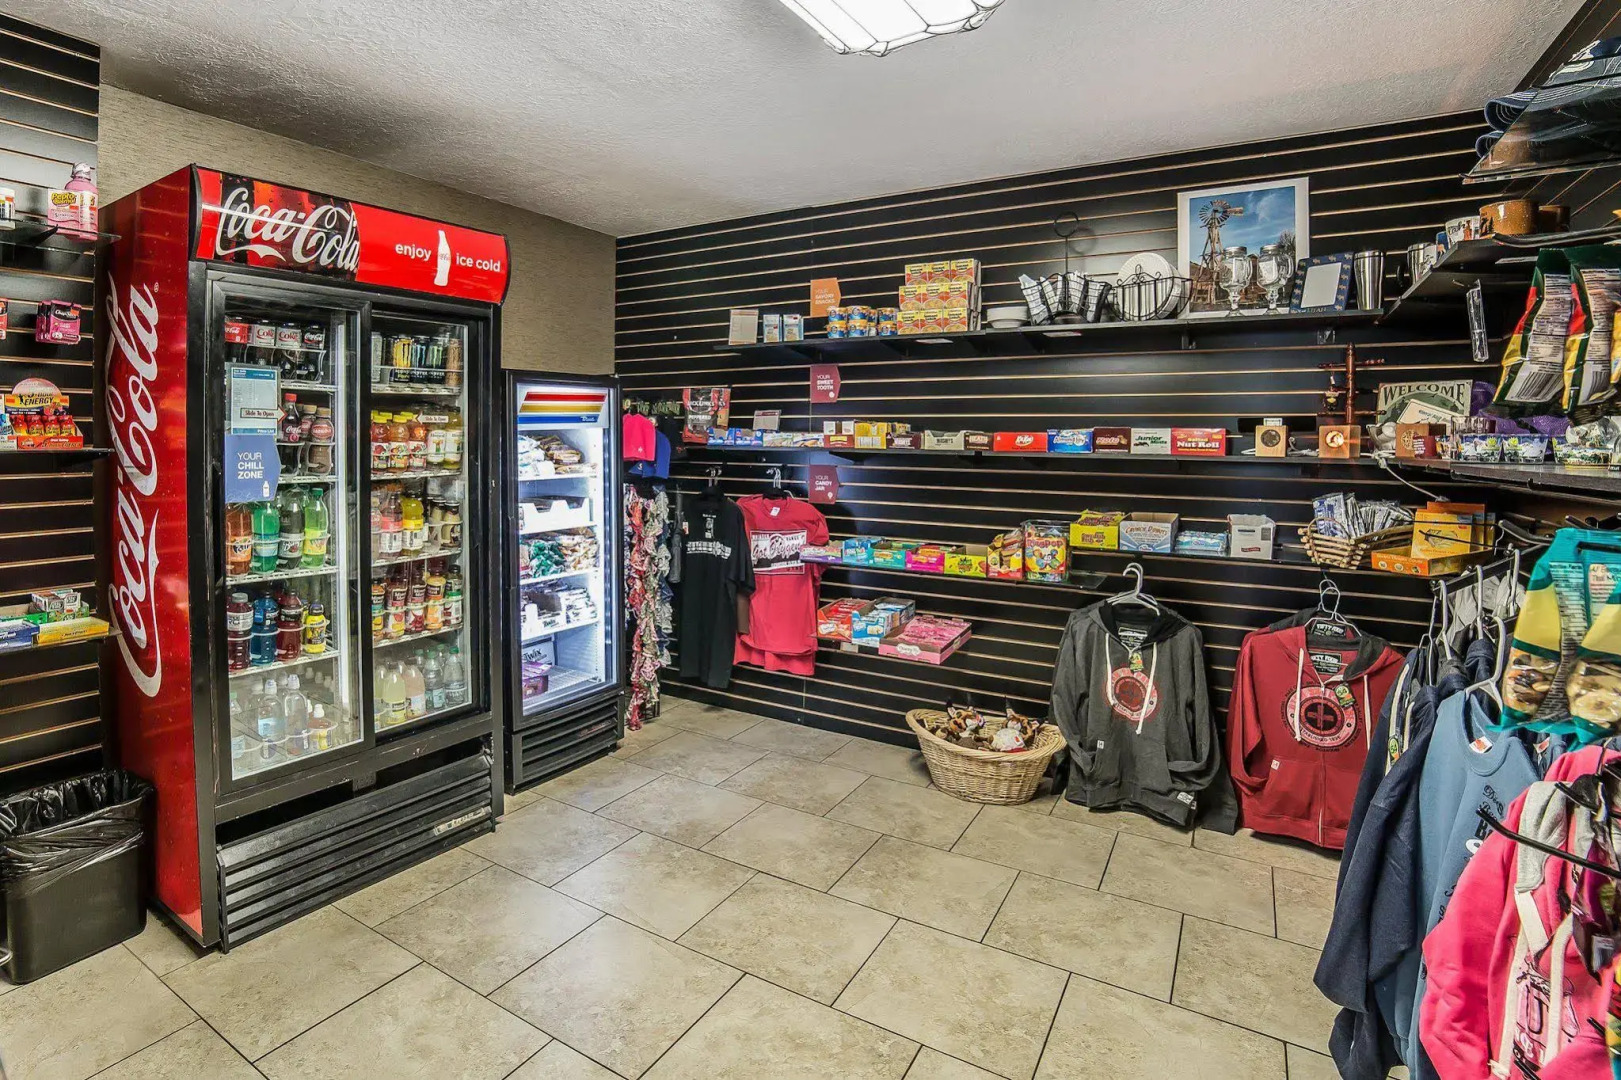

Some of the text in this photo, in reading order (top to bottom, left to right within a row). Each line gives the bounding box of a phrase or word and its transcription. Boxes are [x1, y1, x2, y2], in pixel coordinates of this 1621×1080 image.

[215, 187, 361, 272] Coca-Cola
[394, 242, 501, 273] enjoy ice cold
[1383, 383, 1465, 407] WELCOME
[24, 397, 54, 405] ENERGY
[1176, 441, 1220, 449] Nut Roll
[238, 452, 262, 461] YOUR
[237, 462, 265, 470] CHILL
[237, 470, 264, 479] ZONE
[106, 271, 163, 696] Coca-Cola
[522, 648, 543, 660] Twix
